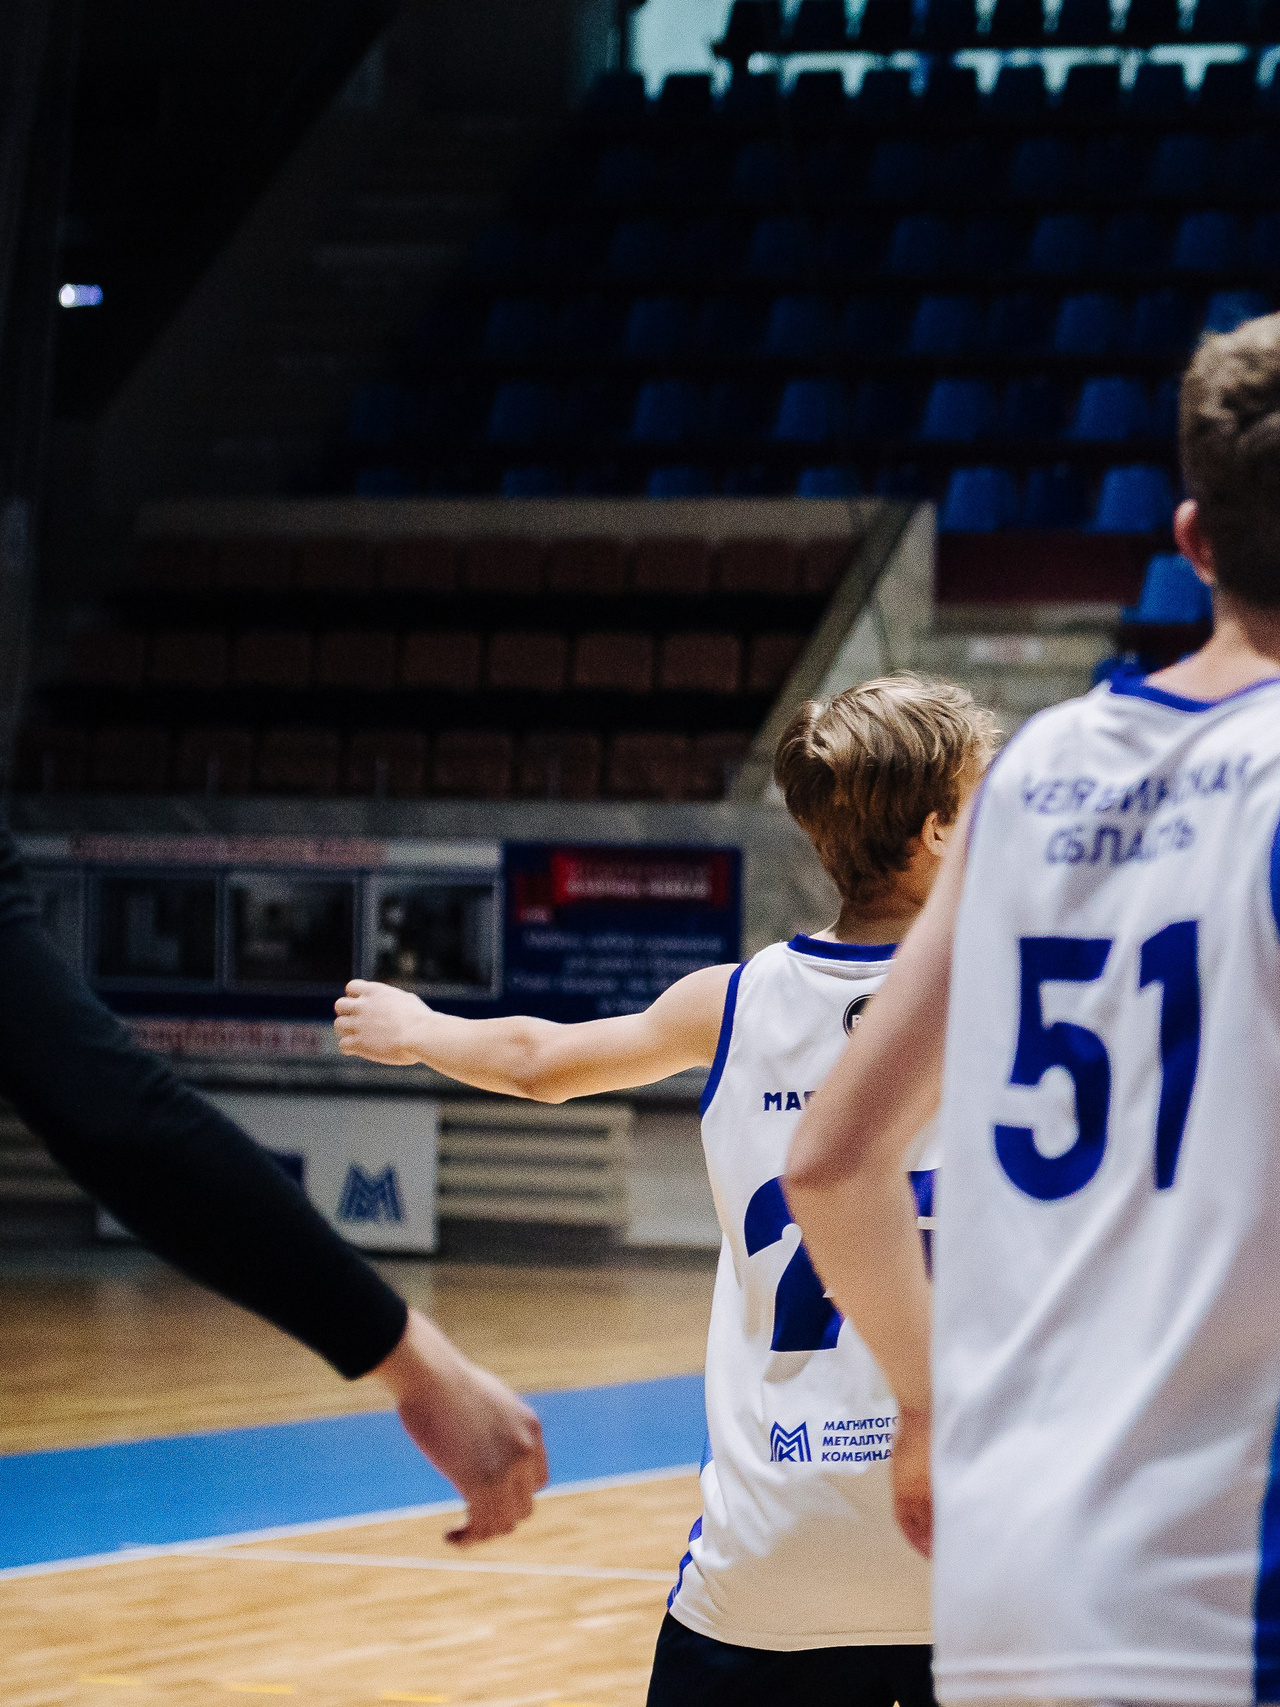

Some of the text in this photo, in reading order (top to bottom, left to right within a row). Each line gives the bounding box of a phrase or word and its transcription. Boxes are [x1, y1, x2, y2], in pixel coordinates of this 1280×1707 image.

[993, 919, 1202, 1200] 51
[822, 1433, 893, 1446] МЕТАЛЛУР
[821, 1449, 892, 1462] КОМБИНА
